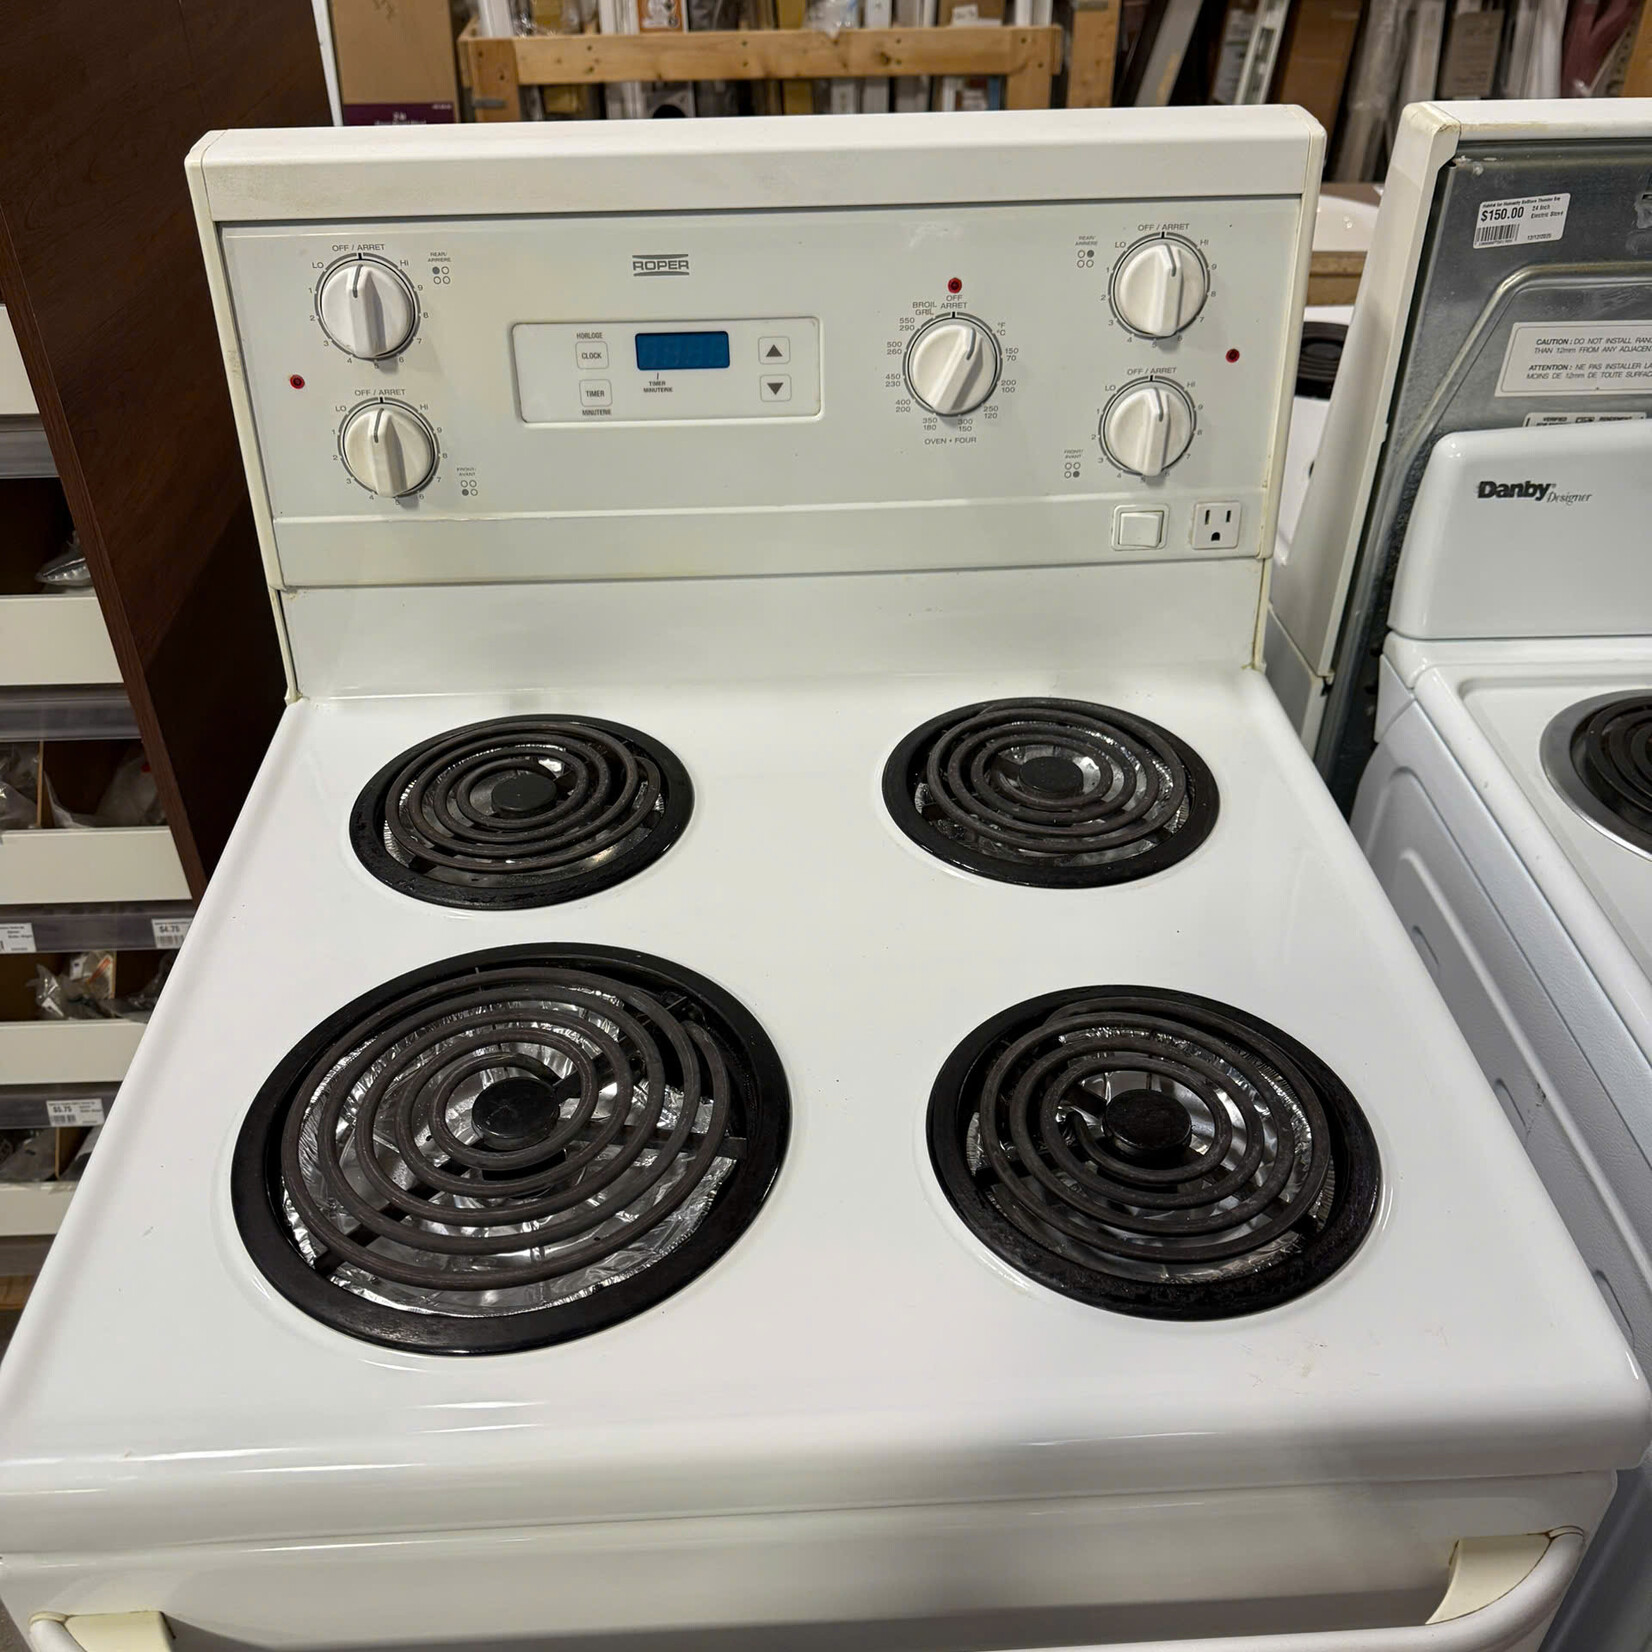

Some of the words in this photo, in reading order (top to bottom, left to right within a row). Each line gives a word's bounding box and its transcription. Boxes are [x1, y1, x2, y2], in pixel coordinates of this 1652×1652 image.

[1481, 206, 1524, 221] $150.00
[1162, 223, 1189, 231] ARRET
[633, 260, 689, 271] ROPER
[586, 390, 605, 398] TIMER
[1478, 481, 1551, 500] Danby
[1547, 491, 1592, 505] Designer
